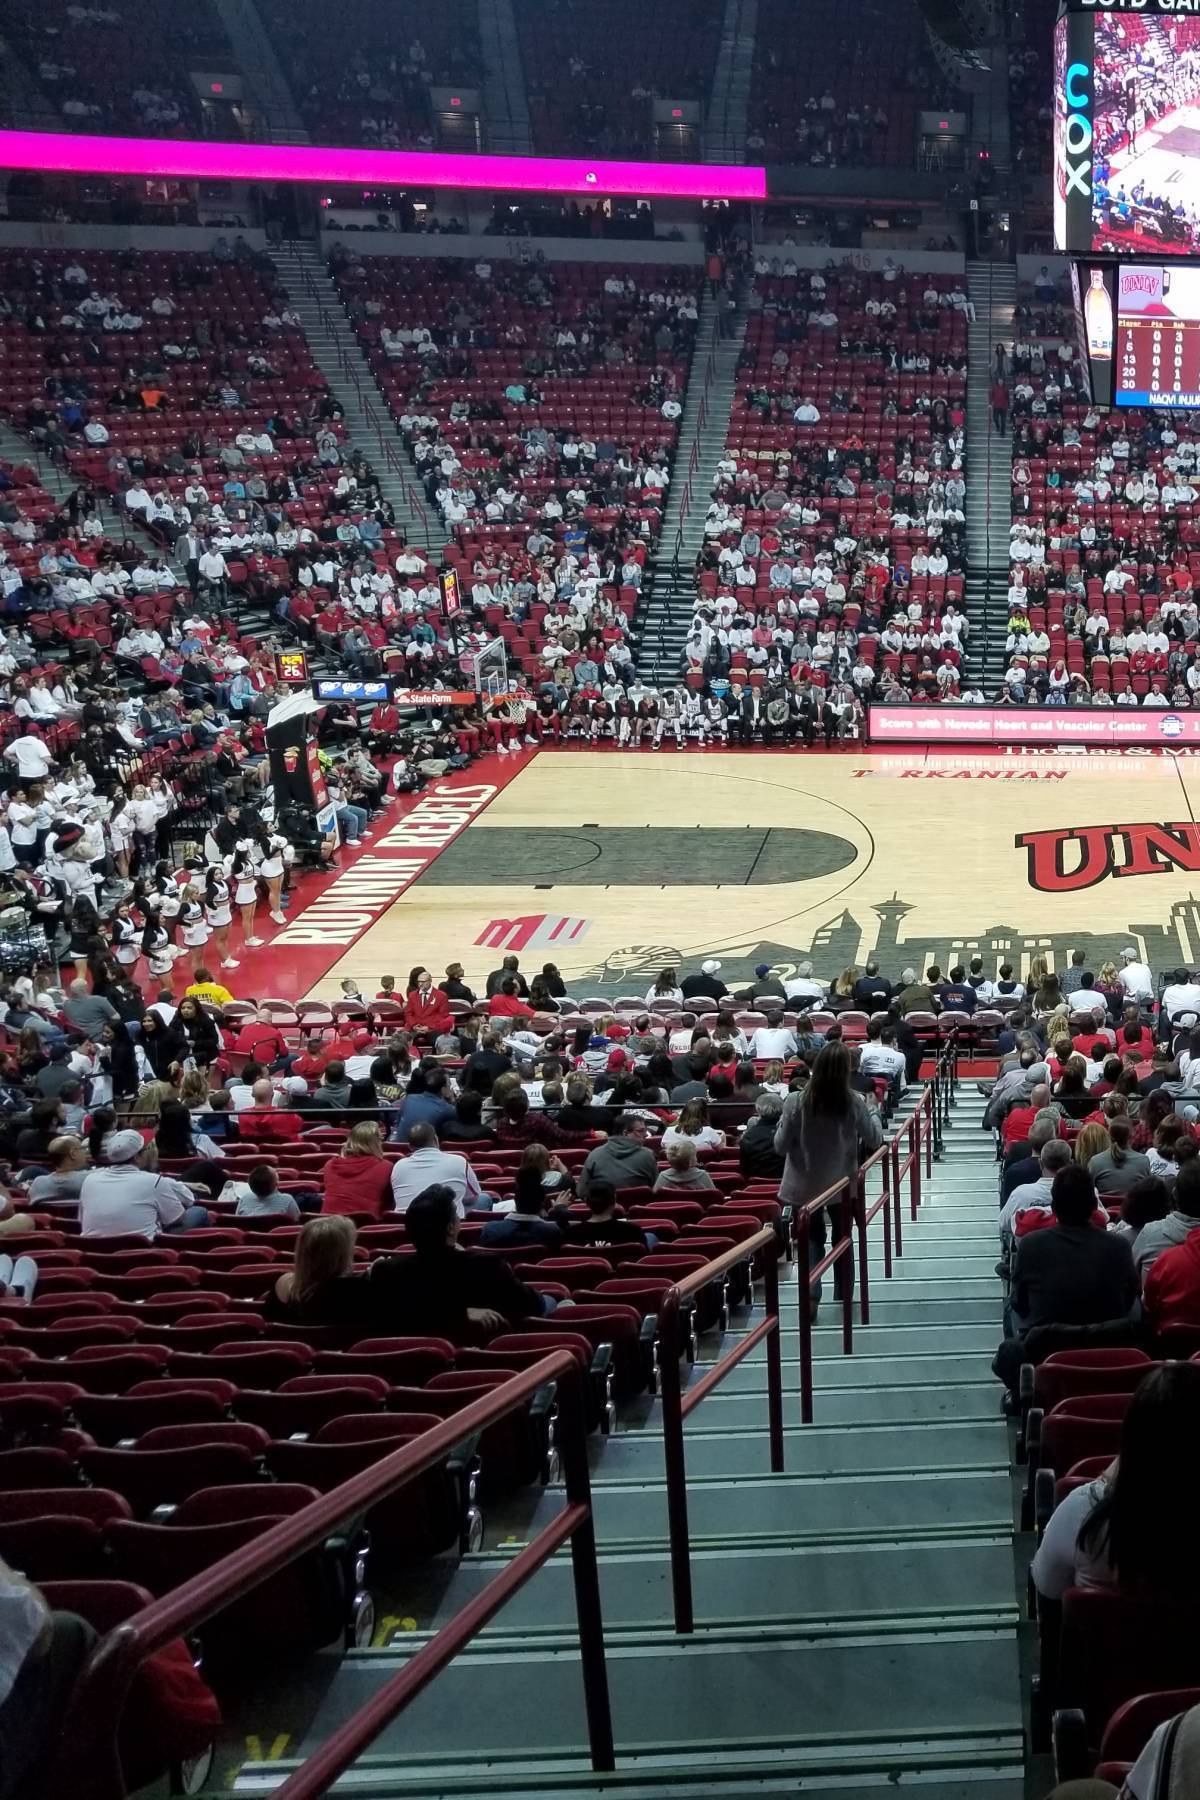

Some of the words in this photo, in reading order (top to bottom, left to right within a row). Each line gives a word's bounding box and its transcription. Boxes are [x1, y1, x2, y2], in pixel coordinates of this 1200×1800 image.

[1066, 63, 1092, 196] COX
[1121, 274, 1159, 297] UNLV
[1118, 320, 1141, 328] Player
[1126, 330, 1133, 339] 1
[1153, 331, 1162, 341] 0
[1175, 332, 1183, 342] 3
[1152, 344, 1161, 354] 0
[1174, 344, 1183, 354] 0
[1122, 355, 1136, 364] 13
[1152, 356, 1161, 366] 0
[1174, 357, 1183, 367] 0
[1122, 367, 1136, 377] 20
[1151, 369, 1160, 378] 4
[1174, 370, 1181, 379] 1
[1121, 380, 1136, 389] 30
[1151, 381, 1160, 391] 0
[1173, 382, 1181, 391] 0
[1149, 393, 1176, 405] NAQVI
[283, 665, 301, 677] 26
[879, 717, 913, 729] Score
[916, 717, 941, 729] with
[945, 717, 991, 730] Nevada
[995, 719, 1027, 730] Heart
[1030, 719, 1053, 731] and
[1055, 720, 1106, 731] Vascular
[1108, 720, 1148, 732] Center
[1124, 747, 1156, 757] &
[851, 769, 1071, 779] TRKANIAN
[373, 784, 499, 848] REBELS
[268, 854, 428, 945] RUNNIN'
